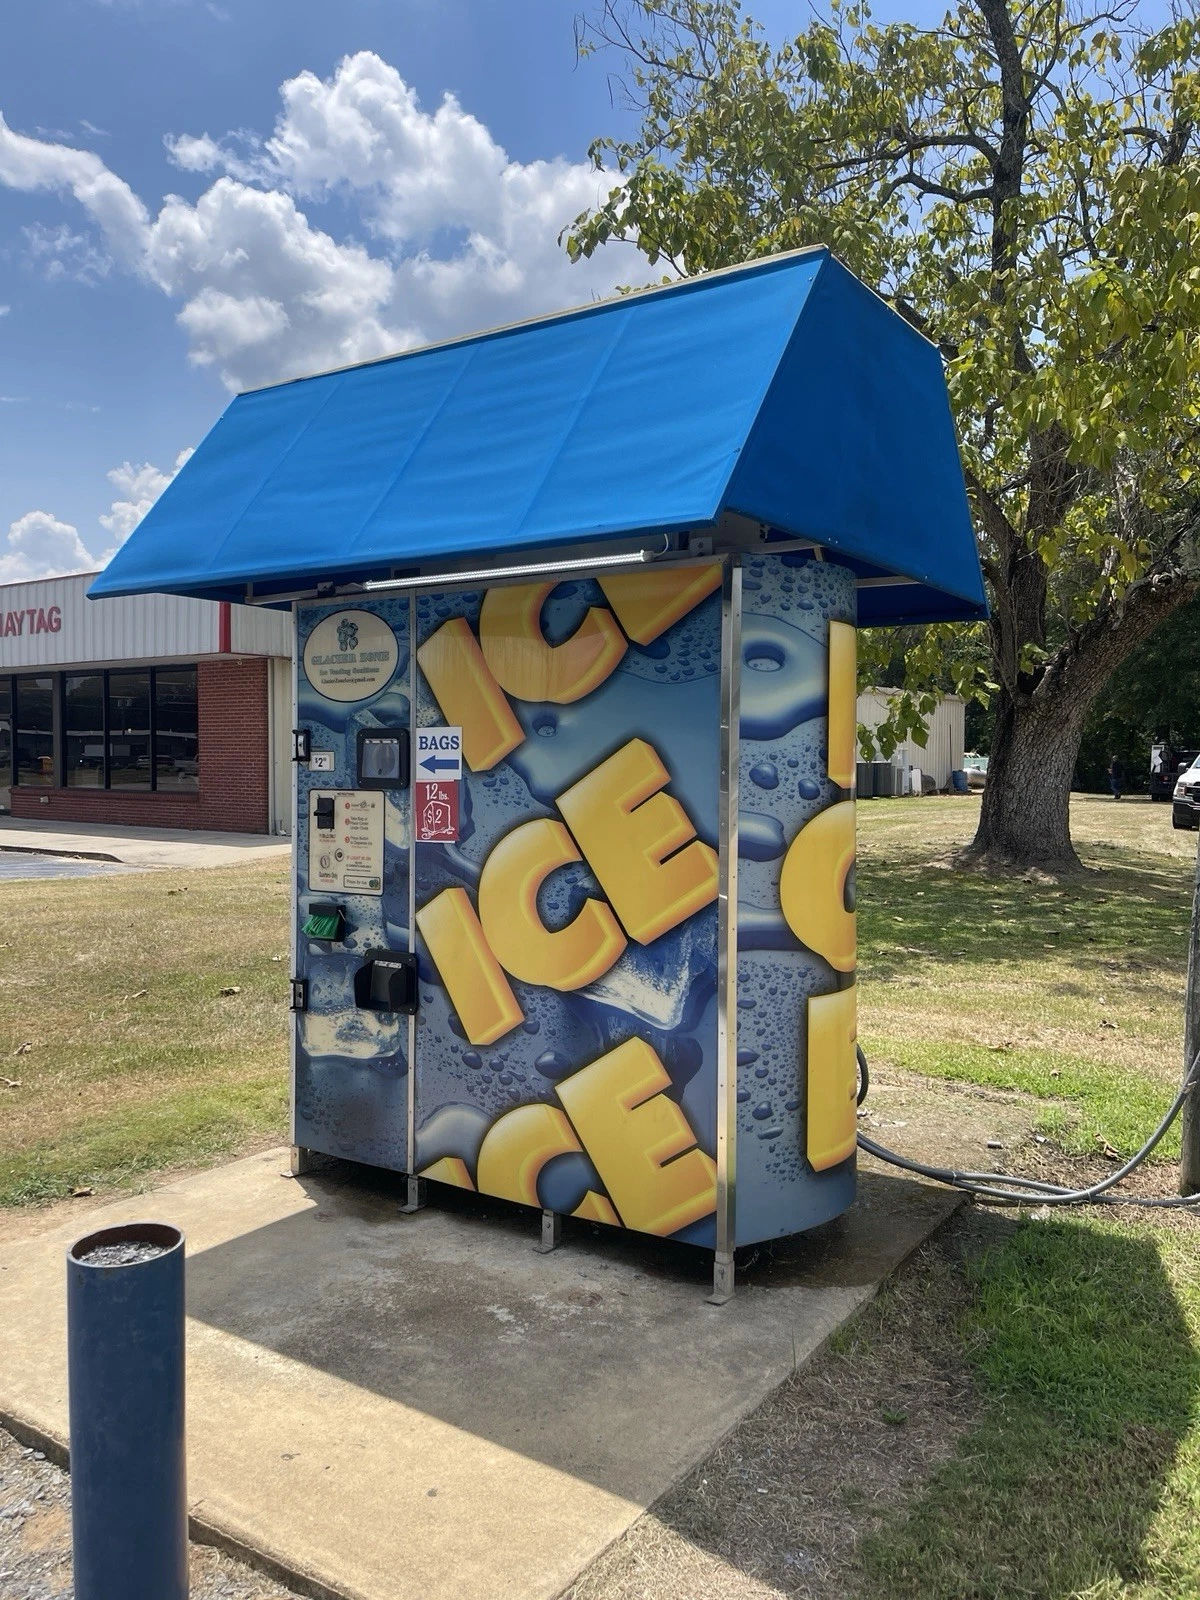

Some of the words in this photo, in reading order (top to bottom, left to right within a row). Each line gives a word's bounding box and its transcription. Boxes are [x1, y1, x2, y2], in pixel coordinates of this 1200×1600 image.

[0, 606, 61, 638] AYTAG
[311, 653, 357, 666] GLACIER
[359, 651, 390, 663] ZONE
[419, 735, 460, 750] BAGS
[426, 783, 438, 801] 12
[438, 790, 449, 800] lbs.
[416, 737, 721, 1046] ICE
[418, 1036, 718, 1237] CE
